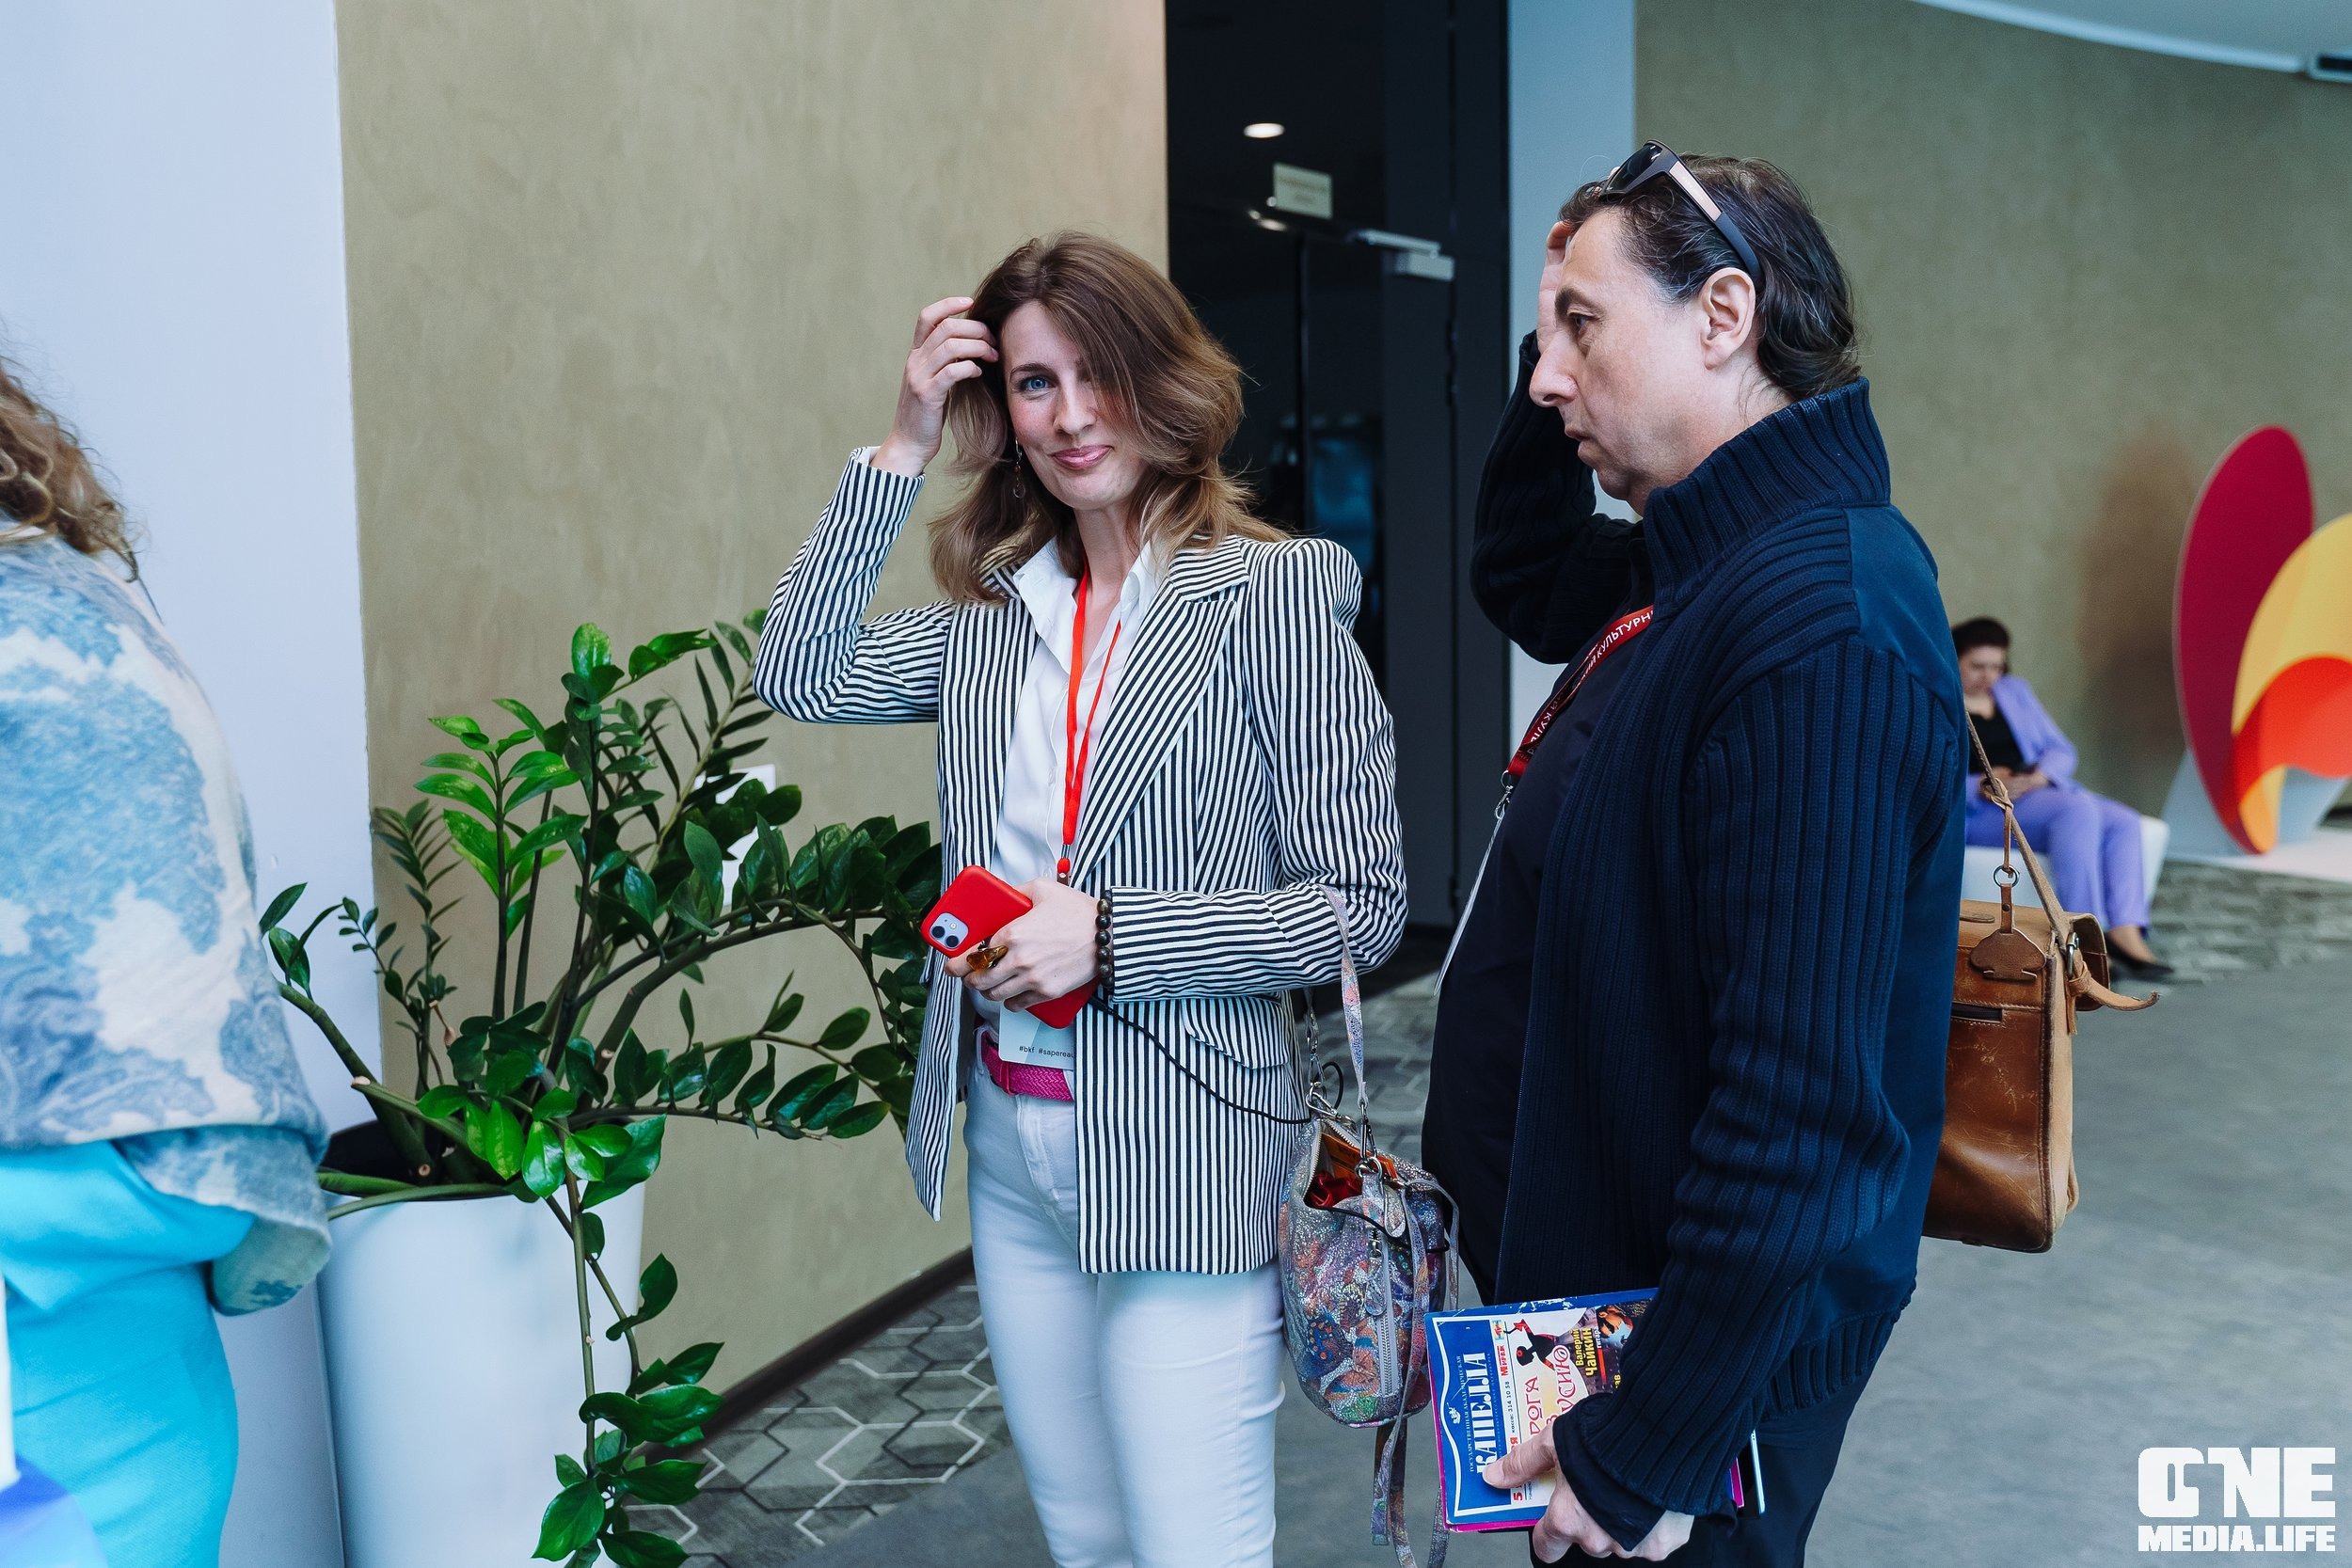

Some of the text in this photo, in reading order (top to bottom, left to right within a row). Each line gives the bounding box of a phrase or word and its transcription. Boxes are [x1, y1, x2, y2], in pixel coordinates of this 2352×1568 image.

[1597, 610, 1654, 658] КУЛЬТУРН
[1019, 1045, 1035, 1053] #bkf
[1570, 1328, 1584, 1366] Валерий
[1581, 1327, 1597, 1376] Чайкин
[1456, 1355, 1474, 1472] ГОСУДАРСТВЕННАЯ АКАДЕМИЧЕСКАЯ
[1463, 1352, 1498, 1474] КАПЕЛЛА
